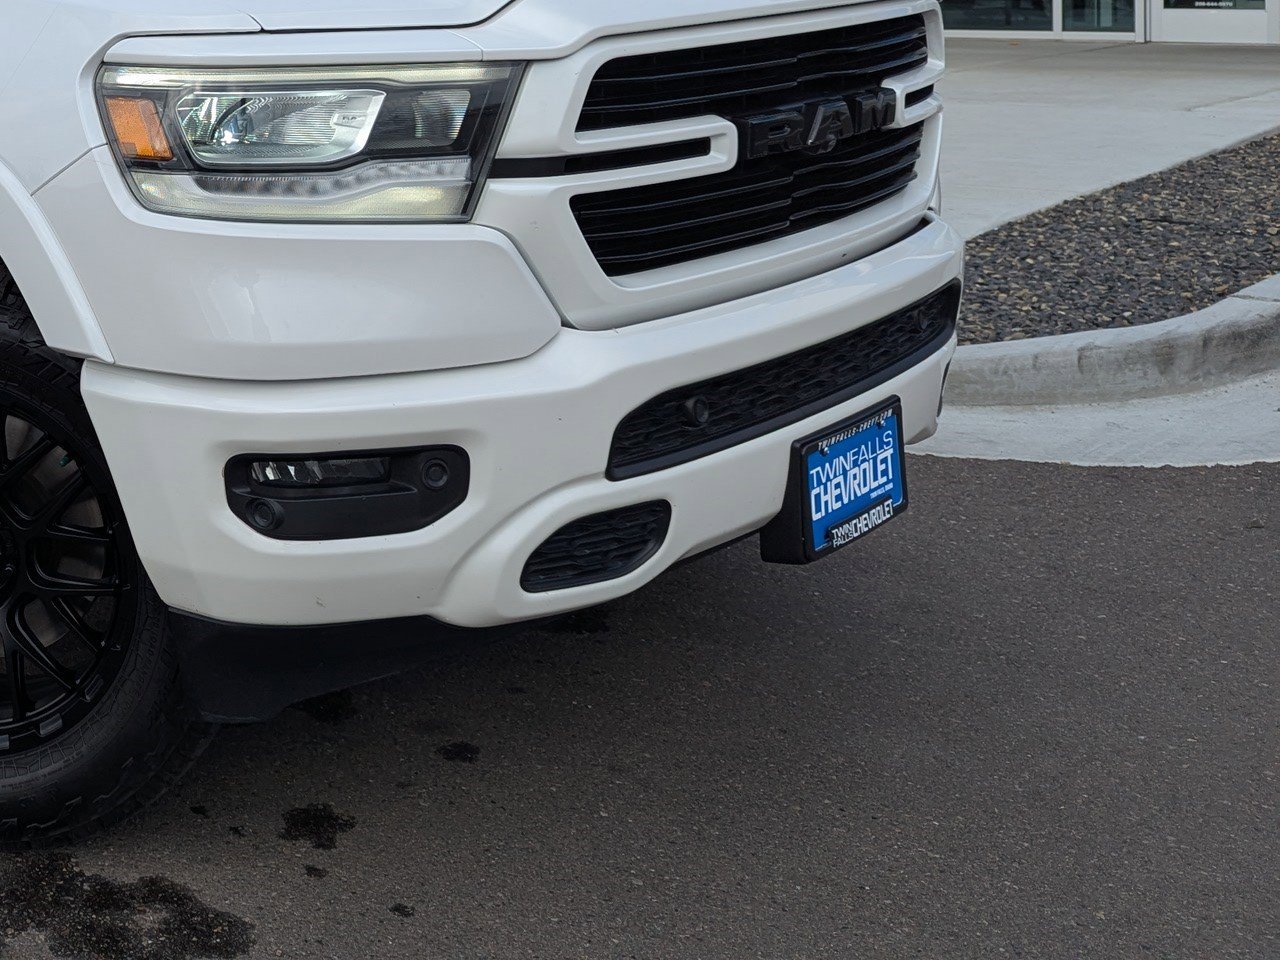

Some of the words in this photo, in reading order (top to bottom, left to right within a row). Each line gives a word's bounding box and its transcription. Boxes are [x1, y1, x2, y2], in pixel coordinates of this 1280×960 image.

[747, 88, 896, 159] RAM
[818, 408, 893, 451] TWINFALLS-CHEVY.COM
[810, 448, 894, 521] CHEVROLET
[831, 522, 853, 540] TWIN
[851, 499, 894, 538] CHEVROLET
[833, 531, 854, 548] FALLS
